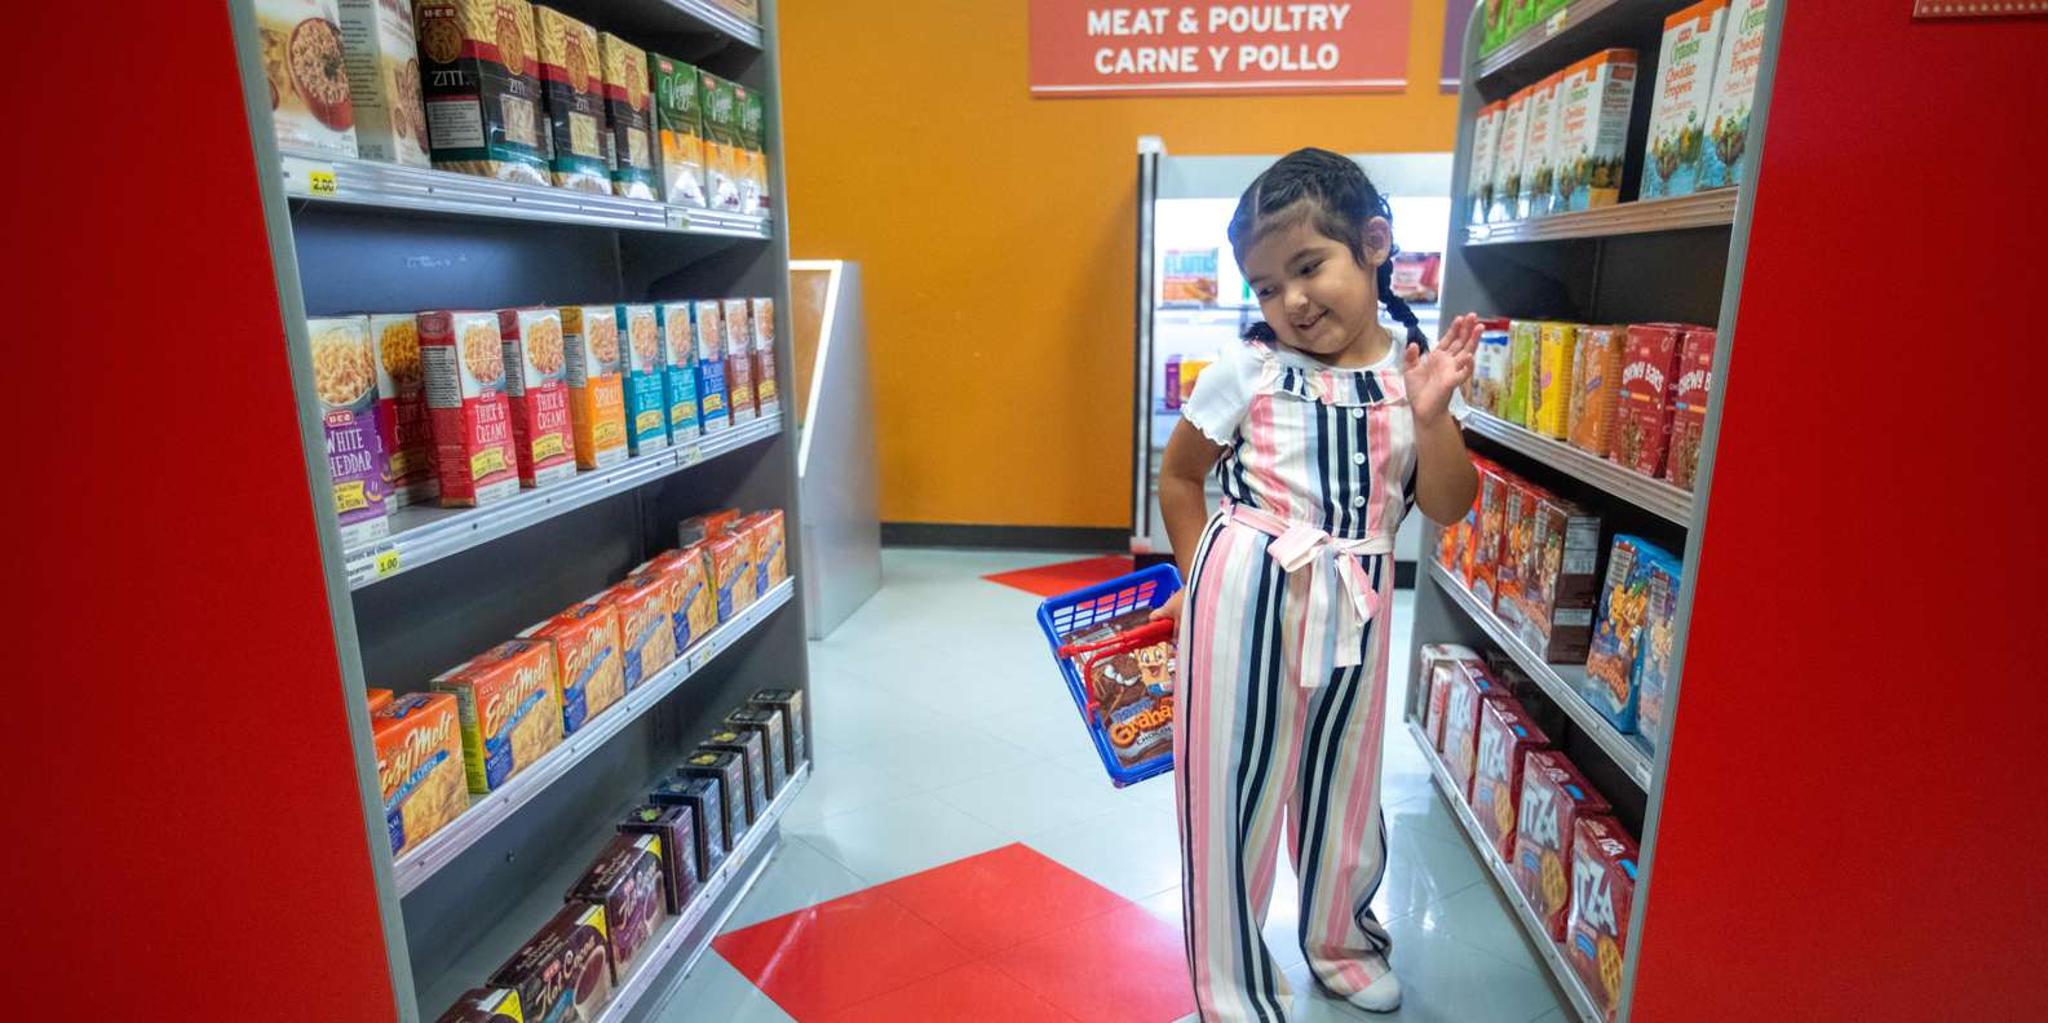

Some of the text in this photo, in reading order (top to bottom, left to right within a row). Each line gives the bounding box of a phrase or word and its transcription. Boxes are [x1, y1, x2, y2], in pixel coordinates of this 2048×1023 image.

[1087, 4, 1350, 36] MEAT & POULTRY
[1094, 43, 1340, 74] CARNE Y POLLO
[312, 177, 335, 193] 2.00
[538, 409, 567, 431] CREAMY
[477, 420, 507, 444] CREAMY
[379, 556, 399, 574] 1.00
